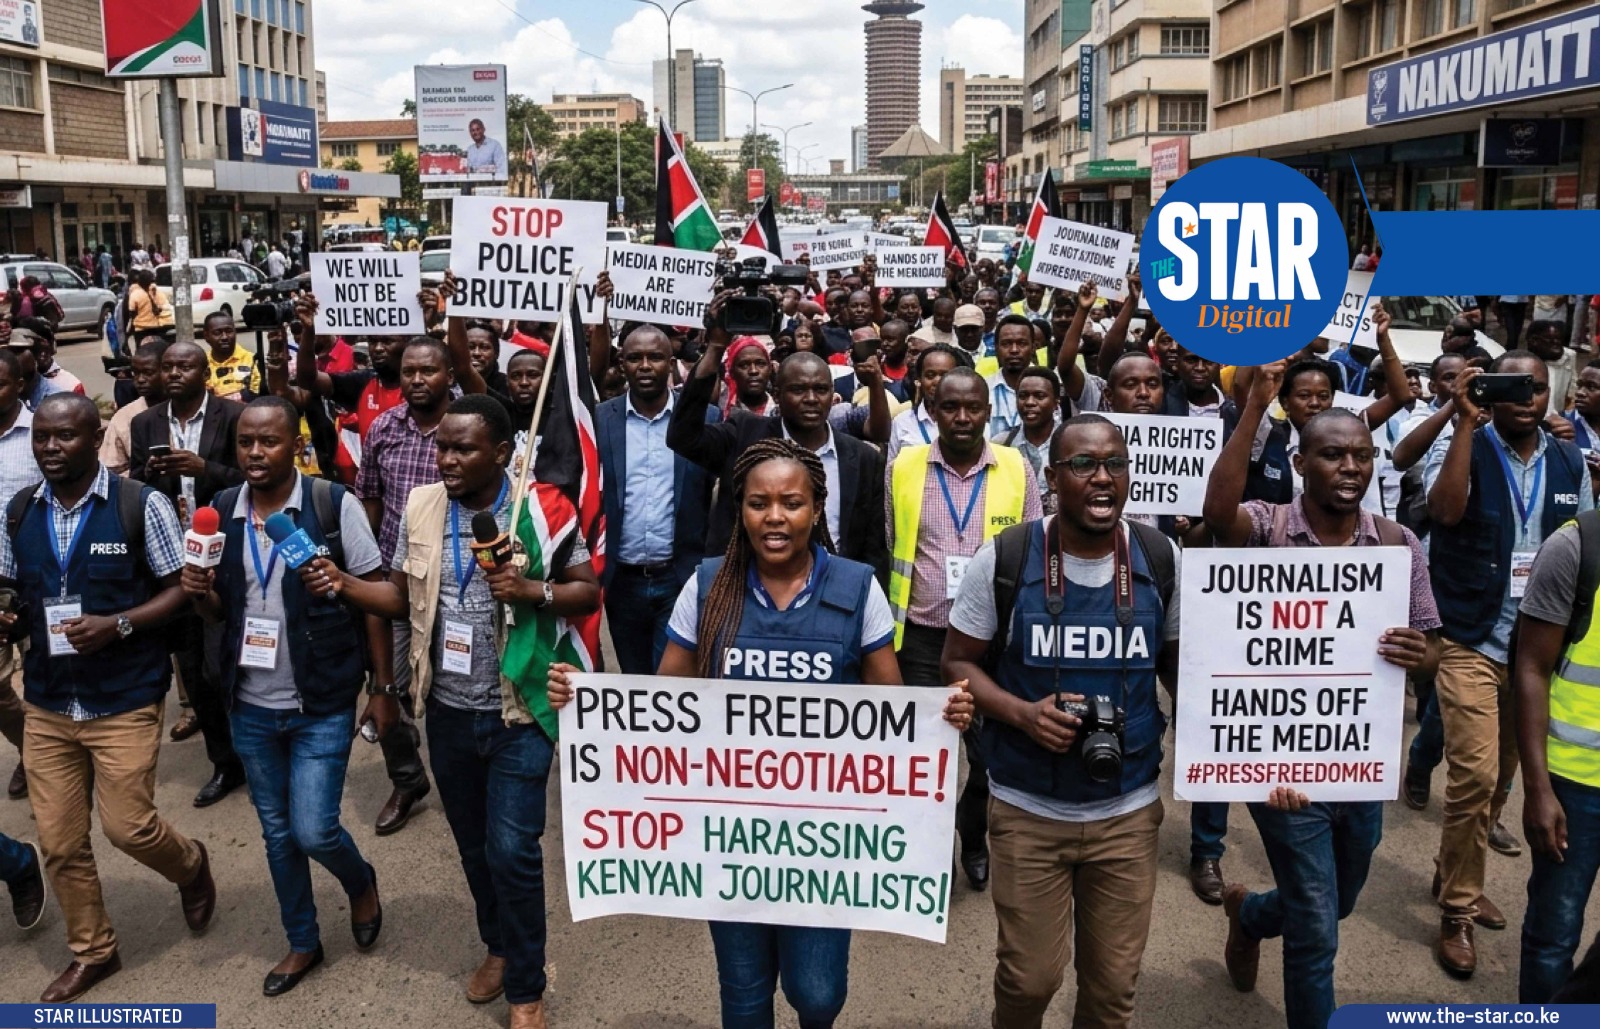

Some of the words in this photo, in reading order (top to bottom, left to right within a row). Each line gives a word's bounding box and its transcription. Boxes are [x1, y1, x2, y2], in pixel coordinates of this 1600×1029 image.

[1398, 14, 1600, 113] NAKUMATT
[491, 206, 563, 238] STOP
[326, 258, 354, 278] WE
[358, 258, 403, 278] WILL
[478, 242, 574, 276] POLICE
[612, 250, 657, 271] MEDIA
[662, 256, 715, 277] RIGHTS
[883, 253, 917, 265] HANDS
[335, 283, 369, 303] NOT
[375, 283, 396, 303] BE
[645, 276, 675, 294] ARE
[325, 307, 410, 327] SILENCED
[1148, 427, 1216, 450] RIGHTS
[1135, 454, 1204, 477] HUMAN
[90, 543, 128, 555] PRESS
[1202, 563, 1383, 593] JOURNALISM
[1237, 601, 1262, 630] IS
[1272, 600, 1328, 629] NOT
[1336, 600, 1355, 628] A
[1031, 624, 1149, 658] MEDIA
[1246, 637, 1334, 666] CRIME
[723, 648, 833, 680] PRESS
[576, 687, 701, 734] PRESS
[726, 693, 916, 742] FREEDOM
[1211, 688, 1307, 717] HANDS
[1317, 688, 1368, 716] OFF
[1210, 725, 1262, 752] THE
[1273, 723, 1371, 752] MEDIA!
[570, 743, 600, 783] IS
[615, 744, 949, 802] NON-NEGOTIABLE!
[1187, 762, 1384, 784] #PRESSFREEDOMKE
[582, 809, 683, 850] STOP
[704, 815, 907, 863] HARASSING
[578, 858, 702, 899] KENYAN
[718, 863, 949, 924] JOURNALISTS!
